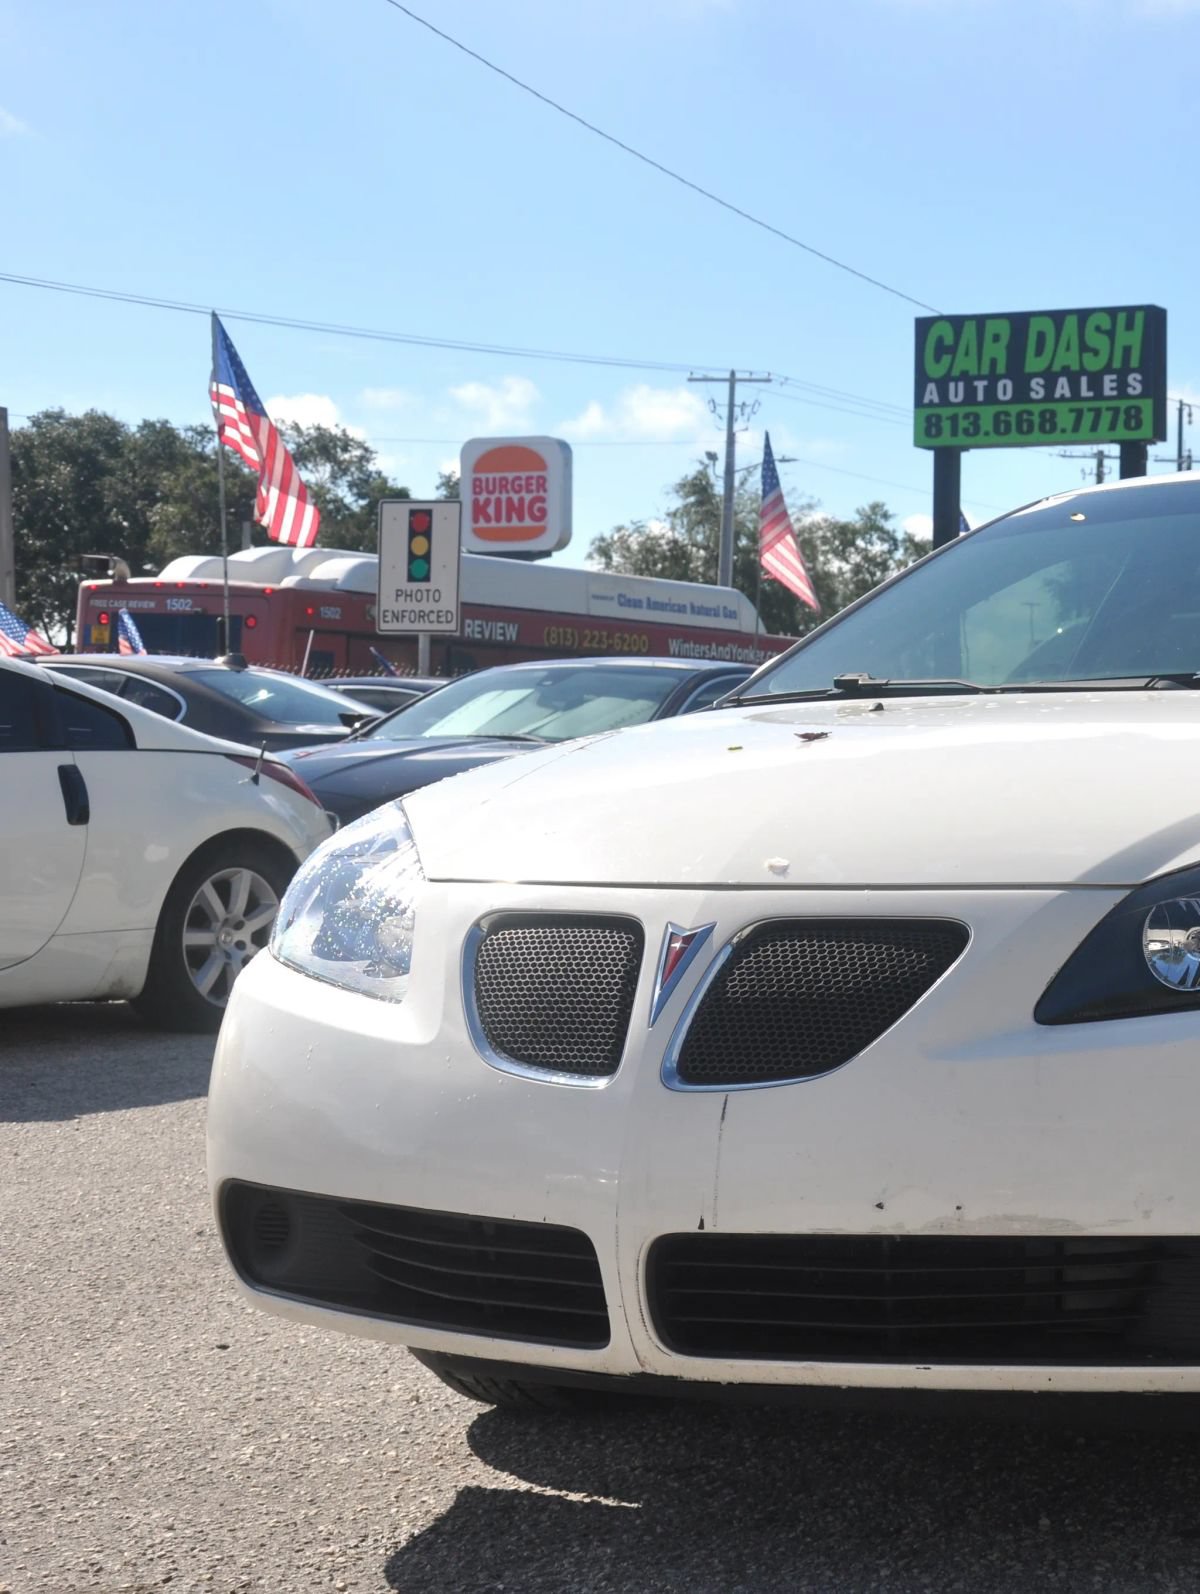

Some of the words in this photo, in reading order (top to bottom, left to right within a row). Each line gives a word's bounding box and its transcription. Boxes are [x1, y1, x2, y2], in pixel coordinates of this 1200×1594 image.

[924, 318, 1011, 379] CAR
[1024, 310, 1145, 373] DASH
[923, 379, 1013, 404] AUTO
[1030, 373, 1142, 399] SALES
[924, 405, 1143, 439] 813.668.7778
[472, 475, 548, 495] BURGER
[472, 495, 548, 524] KING
[109, 600, 128, 608] CASE
[129, 600, 156, 609] REVIEW
[166, 598, 193, 610] 1502
[395, 589, 441, 603] PHOTO
[617, 593, 643, 608] Clean
[646, 597, 687, 614] American
[690, 602, 720, 617] Natural
[723, 606, 738, 620] Gas
[320, 607, 341, 620] 1502
[382, 609, 454, 624] ENFORCED
[465, 619, 519, 641] REVIEW
[543, 626, 579, 648] (813)
[583, 629, 649, 652] 223-6200
